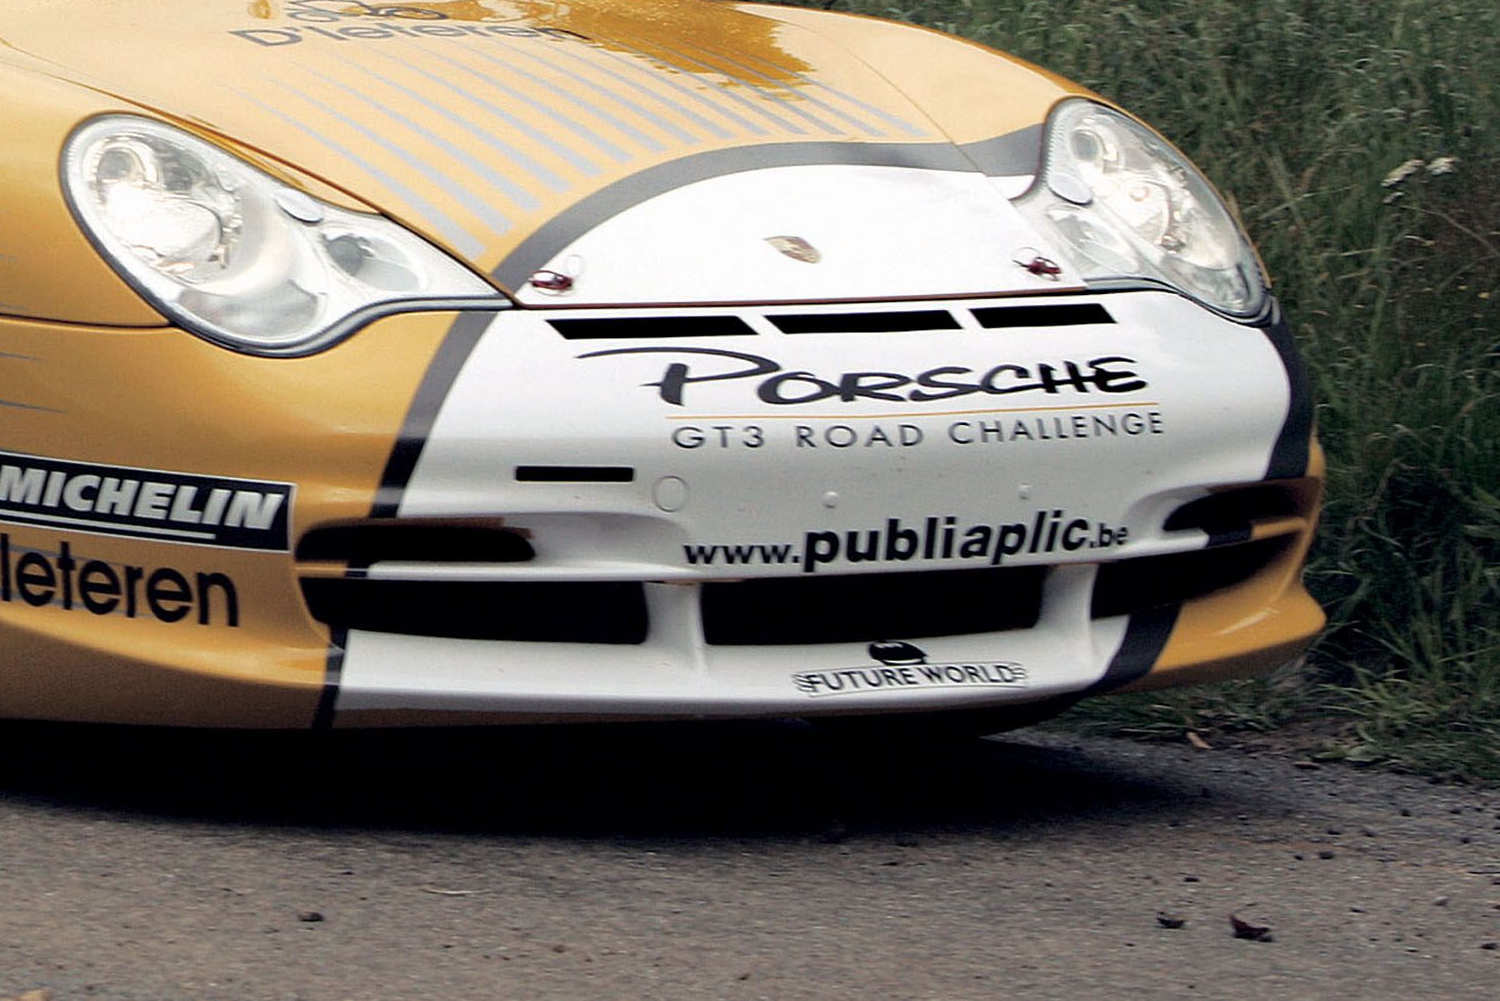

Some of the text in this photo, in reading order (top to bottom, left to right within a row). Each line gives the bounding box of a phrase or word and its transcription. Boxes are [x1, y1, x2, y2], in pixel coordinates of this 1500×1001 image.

[576, 346, 1148, 406] PORSCHE
[672, 411, 1164, 449] GT3 ROAD CHALLENGE
[683, 509, 1129, 573] www.publiaplic.be
[806, 664, 1015, 693] FUTURE WORLD
